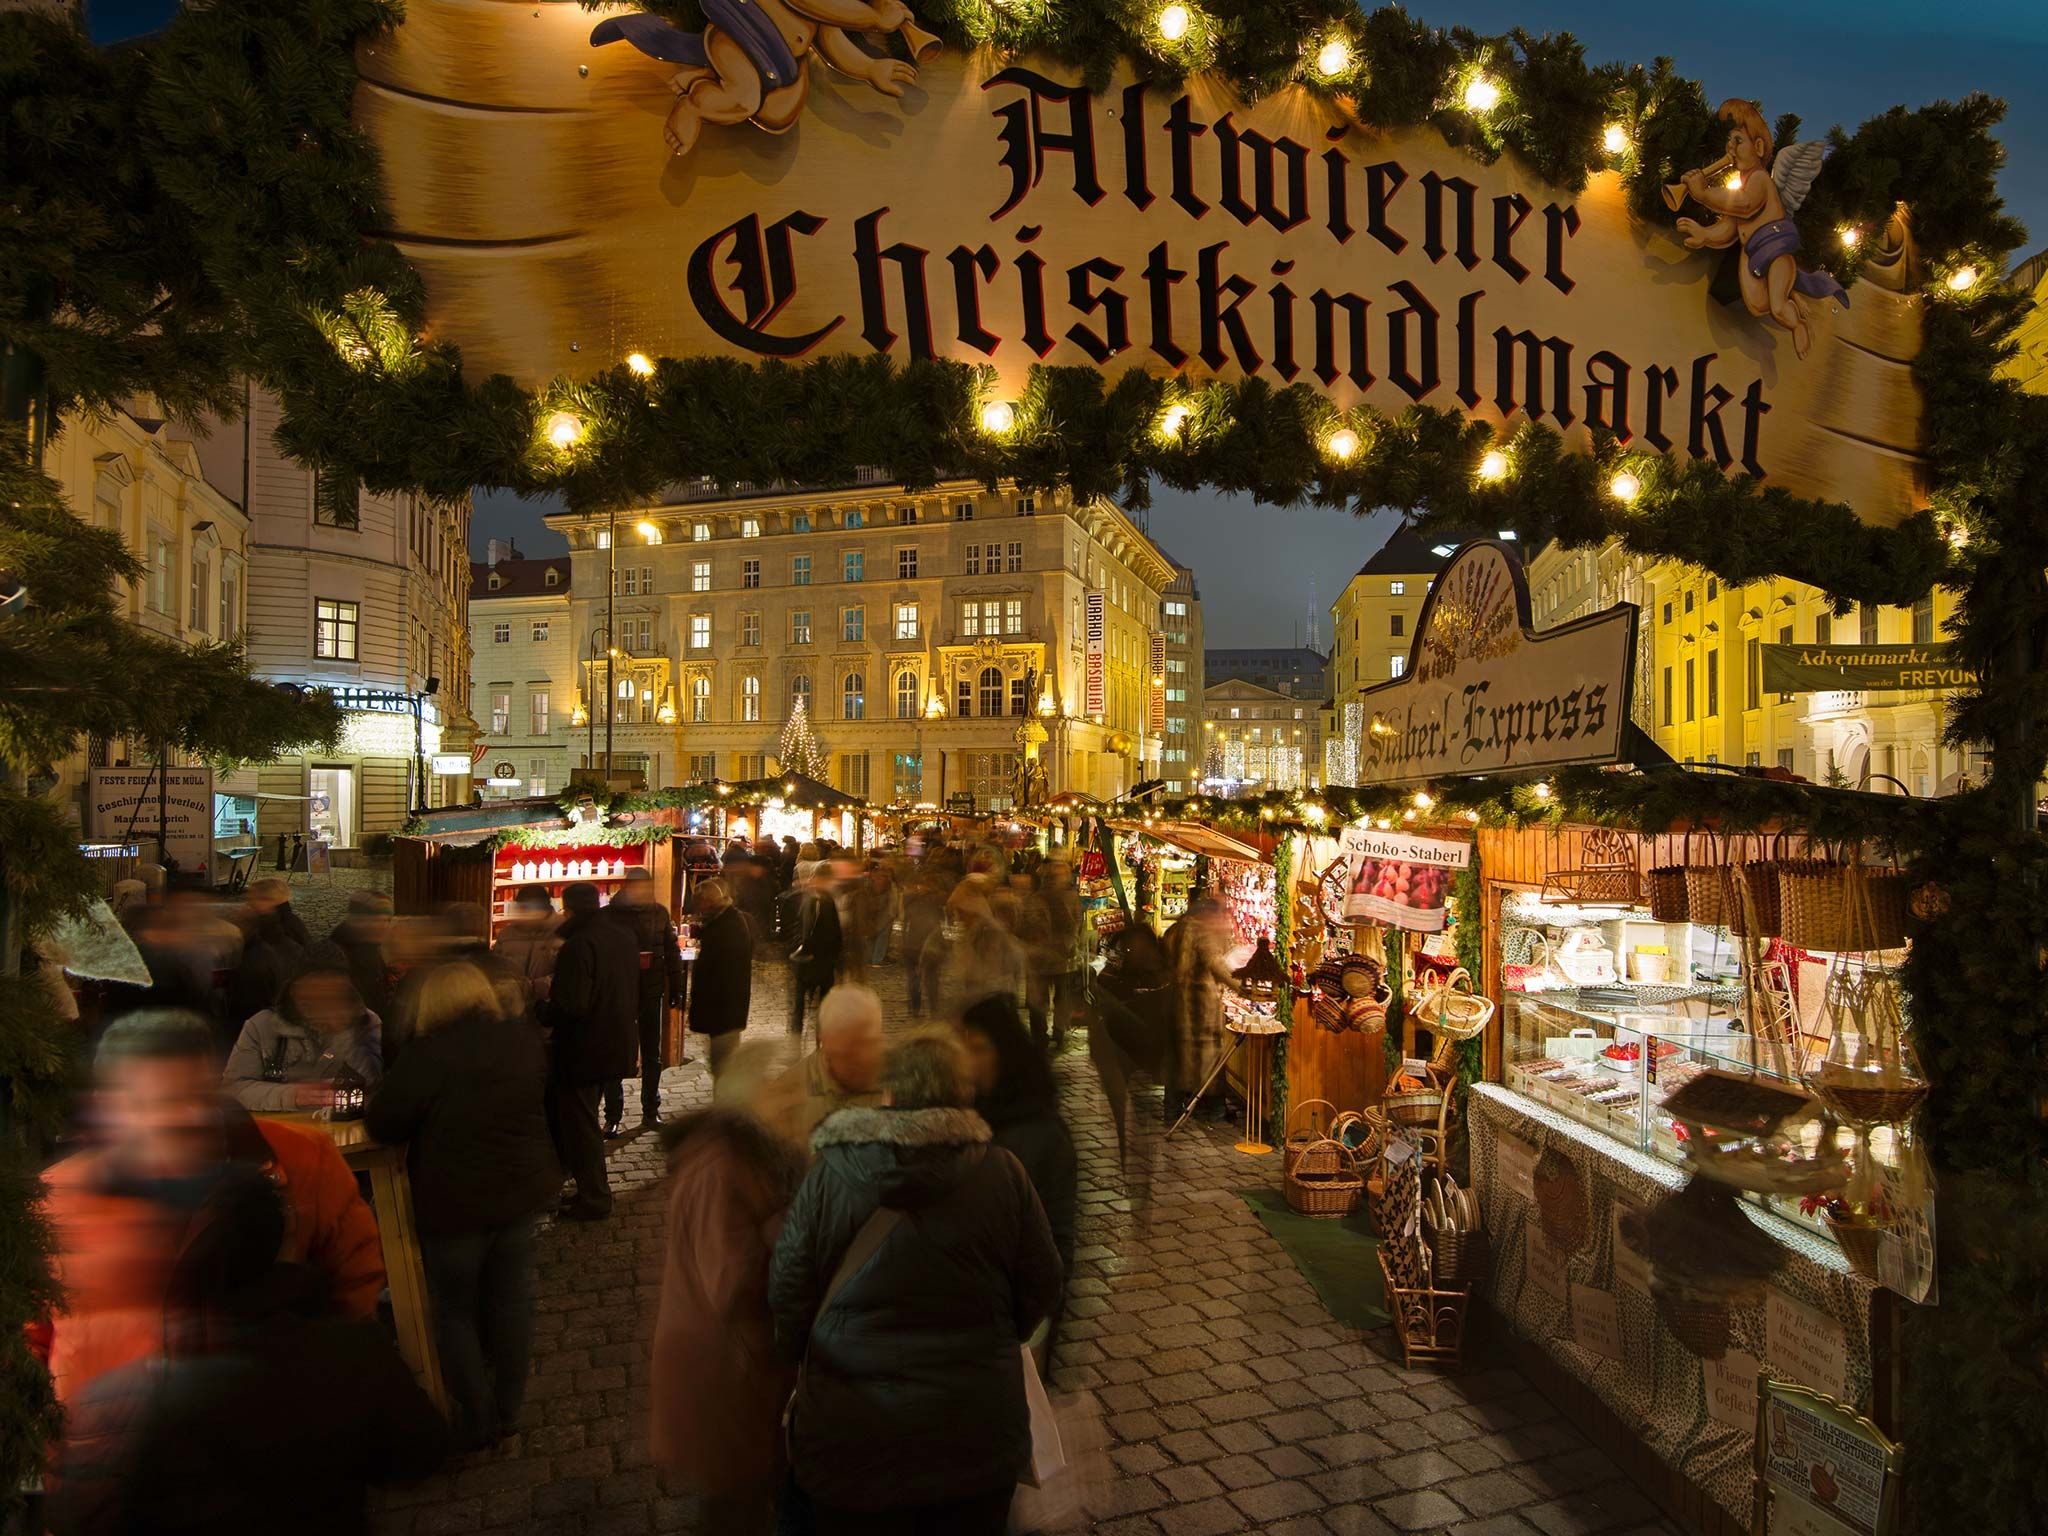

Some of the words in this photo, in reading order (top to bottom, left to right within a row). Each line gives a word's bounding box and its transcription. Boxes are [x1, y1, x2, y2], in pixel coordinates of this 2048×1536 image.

[981, 66, 1581, 296] Altwiener
[686, 205, 1772, 480] Christkindlmarkt
[1087, 595, 1102, 644] WARHOL
[1152, 637, 1164, 675] WARHOL
[1798, 648, 1928, 666] Adventmarkt
[1088, 653, 1103, 711] BASQUIAT
[99, 776, 126, 785] FESTE
[160, 776, 180, 785] HNE
[182, 774, 205, 785] MÜLL
[153, 815, 190, 825] Lprich
[1775, 1302, 1794, 1321] Wir
[1794, 1315, 1838, 1347] flechten
[1779, 1323, 1800, 1345] Ihre
[1801, 1336, 1834, 1365] Sessel
[1714, 1360, 1753, 1391] Wiener
[1772, 1341, 1800, 1362] gerne
[1801, 1361, 1821, 1377] neu
[1823, 1373, 1839, 1388] ein
[1715, 1387, 1756, 1416] Geflech
[1793, 1459, 1809, 1477] alle
[1813, 1426, 1884, 1471] EINFLECHTUNGEN
[1767, 1454, 1811, 1490] Korbwaren
